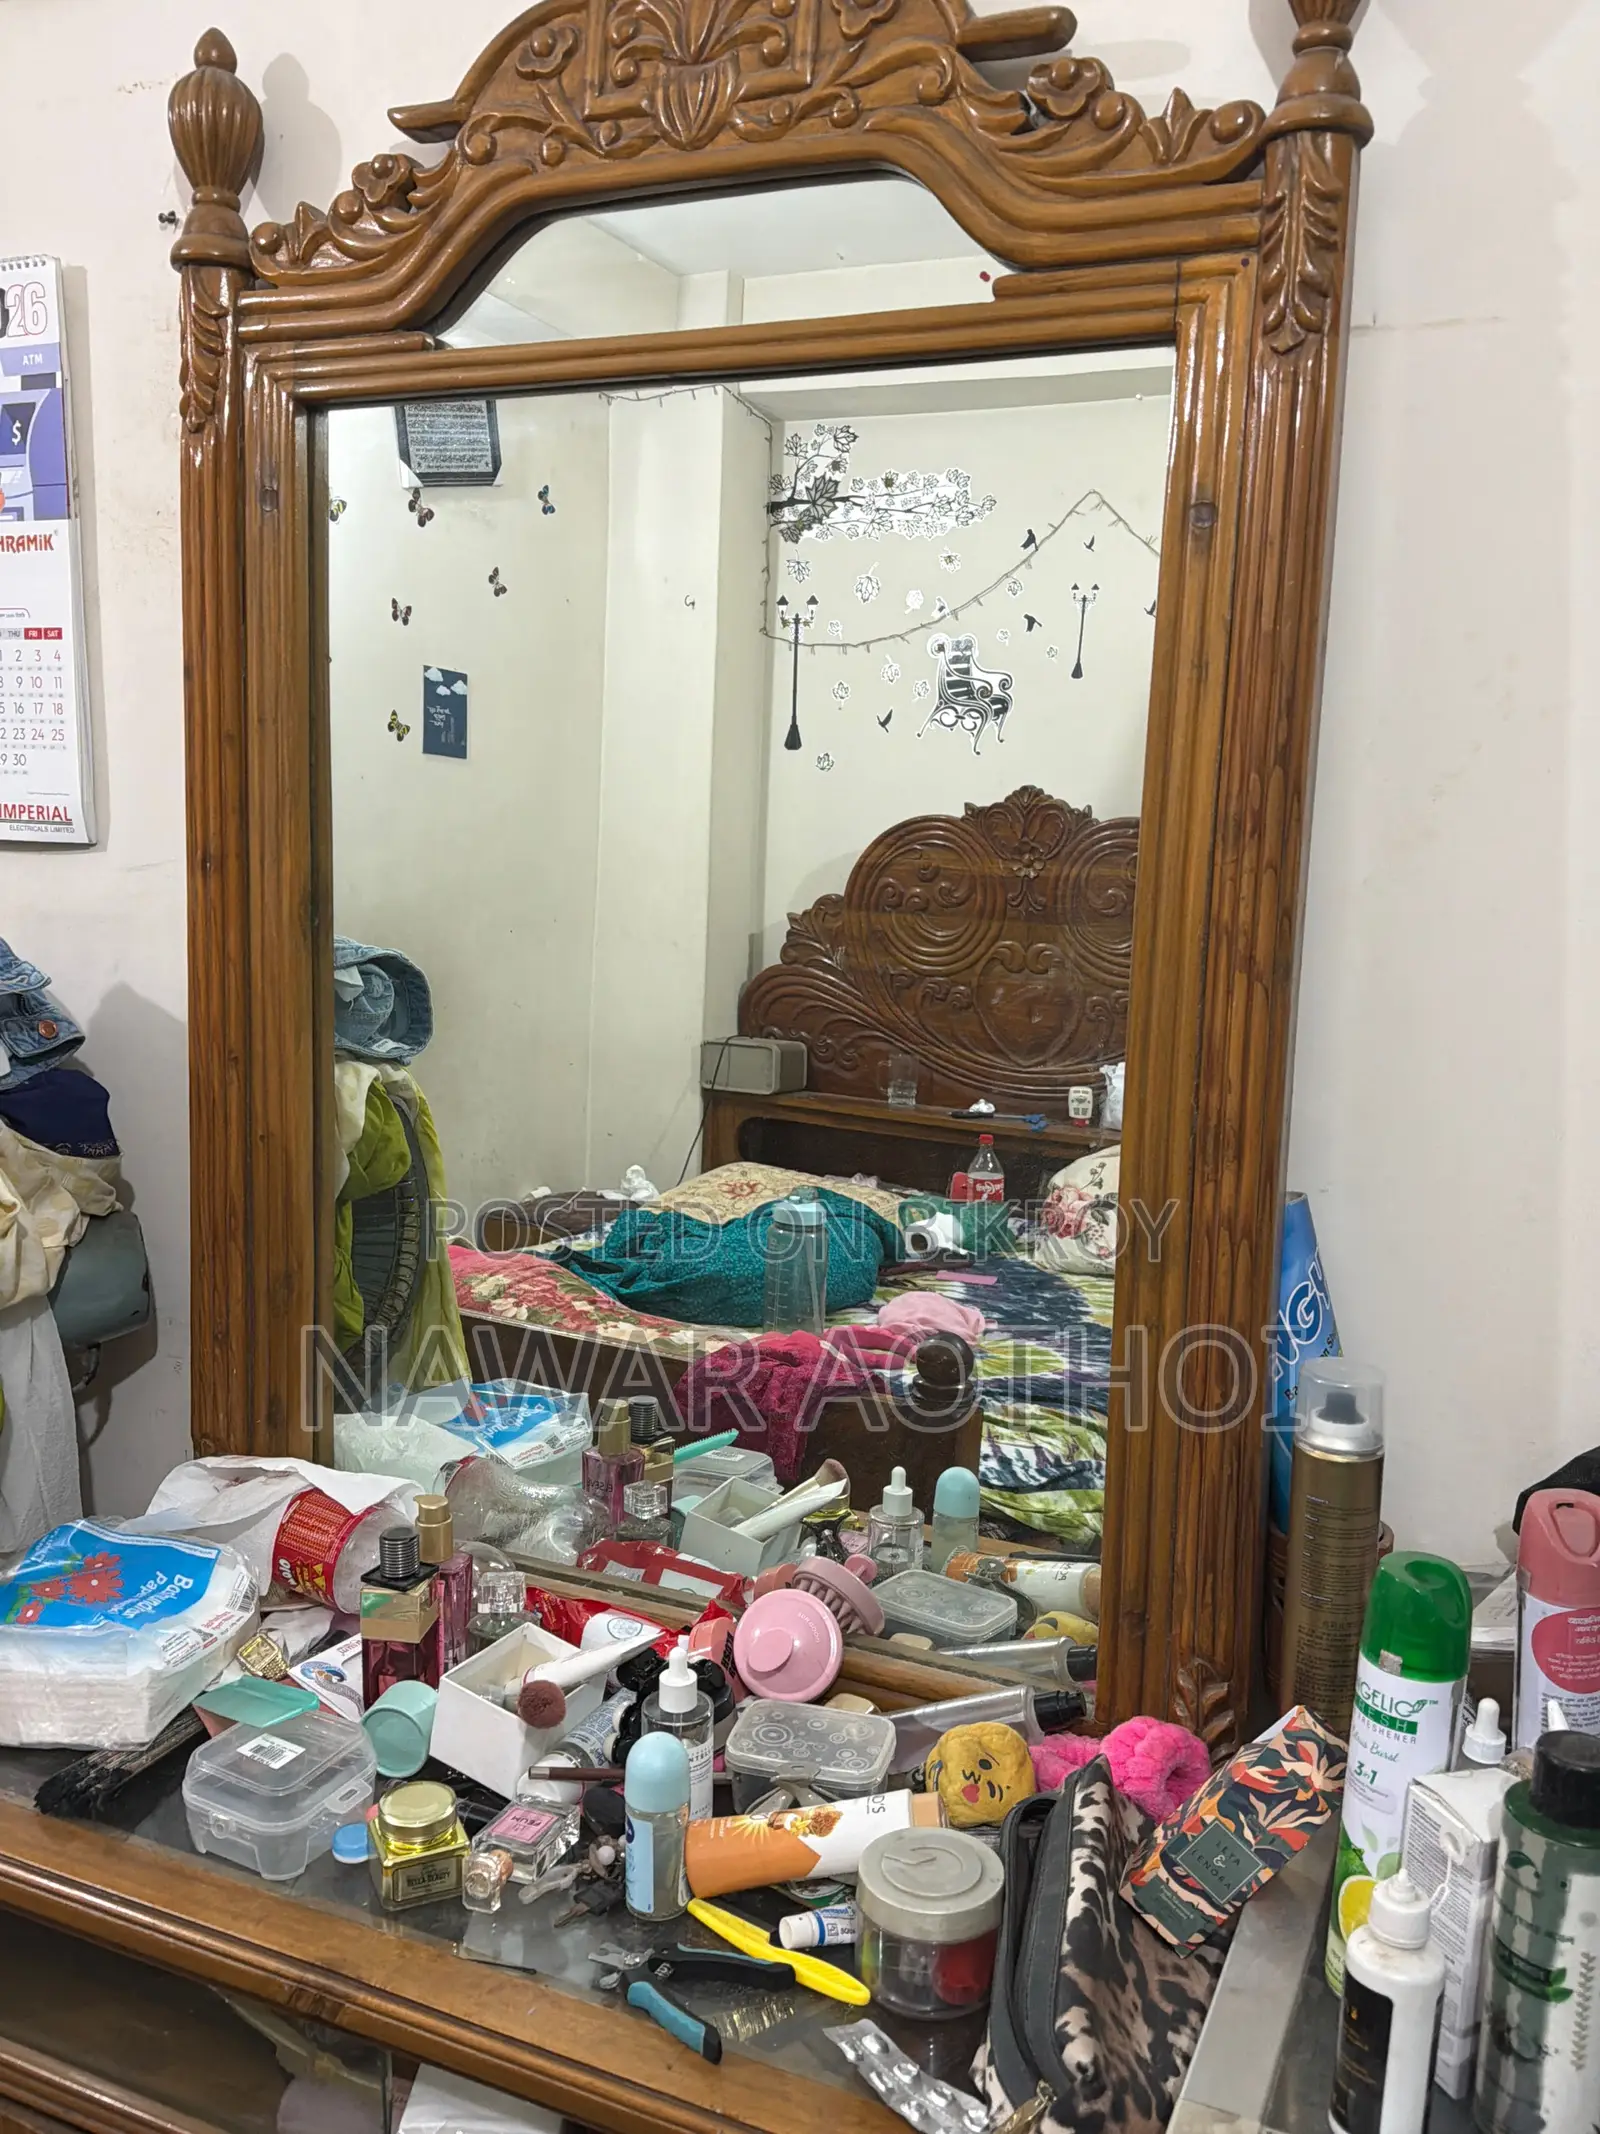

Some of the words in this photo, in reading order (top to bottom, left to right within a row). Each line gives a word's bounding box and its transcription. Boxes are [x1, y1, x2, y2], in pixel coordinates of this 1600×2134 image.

[22, 354, 43, 366] ATM
[28, 630, 38, 638] FRI
[47, 629, 59, 638] SAT
[15, 649, 22, 662] 2
[34, 649, 41, 662] 3
[54, 650, 61, 662] 4
[16, 676, 23, 688] 9
[30, 676, 42, 689] 10
[54, 676, 62, 689] 11
[13, 702, 24, 714] 16
[33, 702, 43, 715] 17
[52, 702, 63, 715] 18
[13, 728, 25, 740] 23
[31, 728, 44, 741] 24
[52, 728, 65, 741] 25
[13, 753, 26, 766] 30
[0, 803, 72, 822] IMPERIAL
[1213, 1854, 1225, 1868] &
